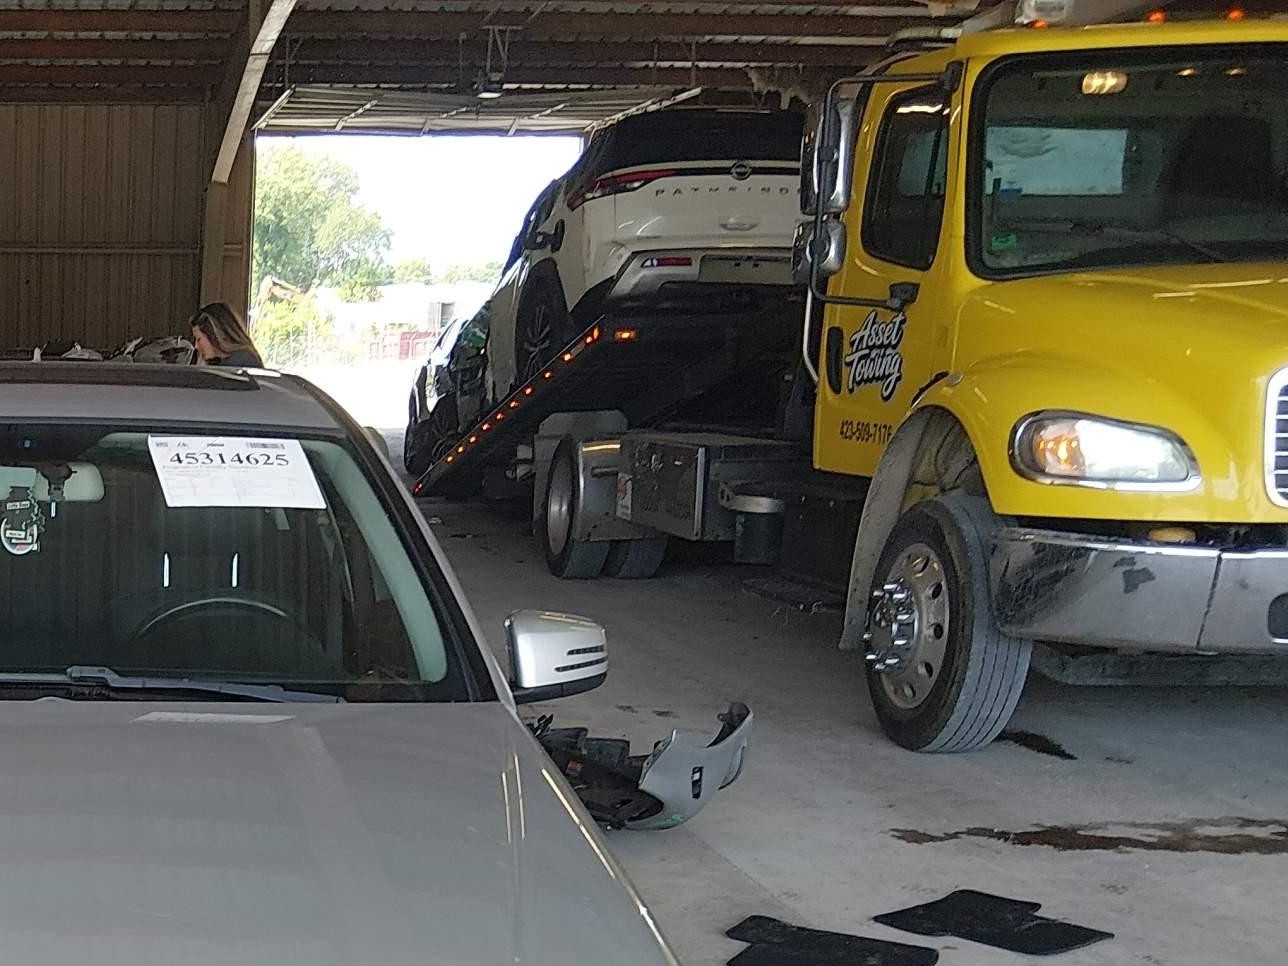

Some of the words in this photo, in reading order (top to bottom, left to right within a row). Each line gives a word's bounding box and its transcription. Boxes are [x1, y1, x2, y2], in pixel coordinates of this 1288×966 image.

[850, 310, 907, 352] Asset
[845, 348, 903, 400] Towing
[169, 452, 289, 467] 45314625
